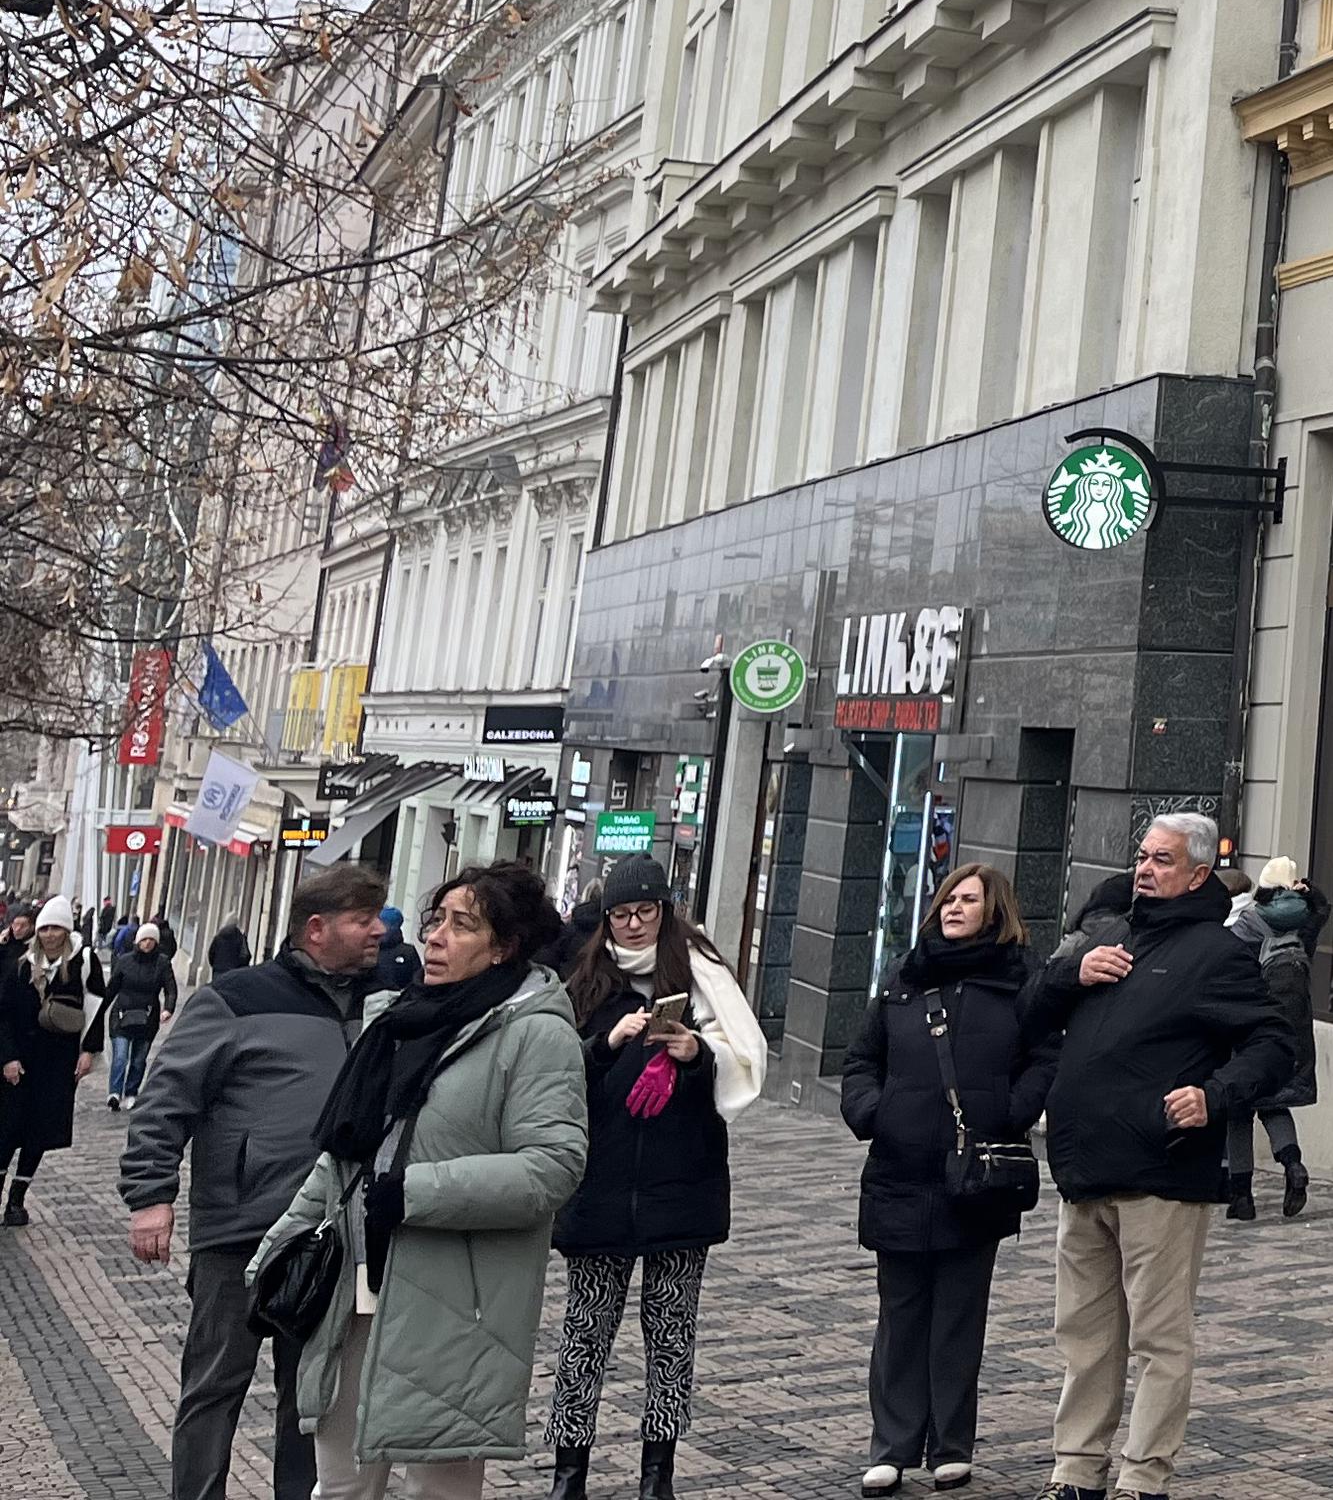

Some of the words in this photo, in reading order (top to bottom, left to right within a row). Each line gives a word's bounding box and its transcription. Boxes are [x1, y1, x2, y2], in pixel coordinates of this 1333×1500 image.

[743, 644, 777, 663] LINK
[837, 612, 907, 695] LINK
[909, 606, 959, 695] 86
[614, 815, 640, 824] TABAC
[601, 825, 649, 834] SOUVENIRS
[596, 835, 651, 850] MARKET
